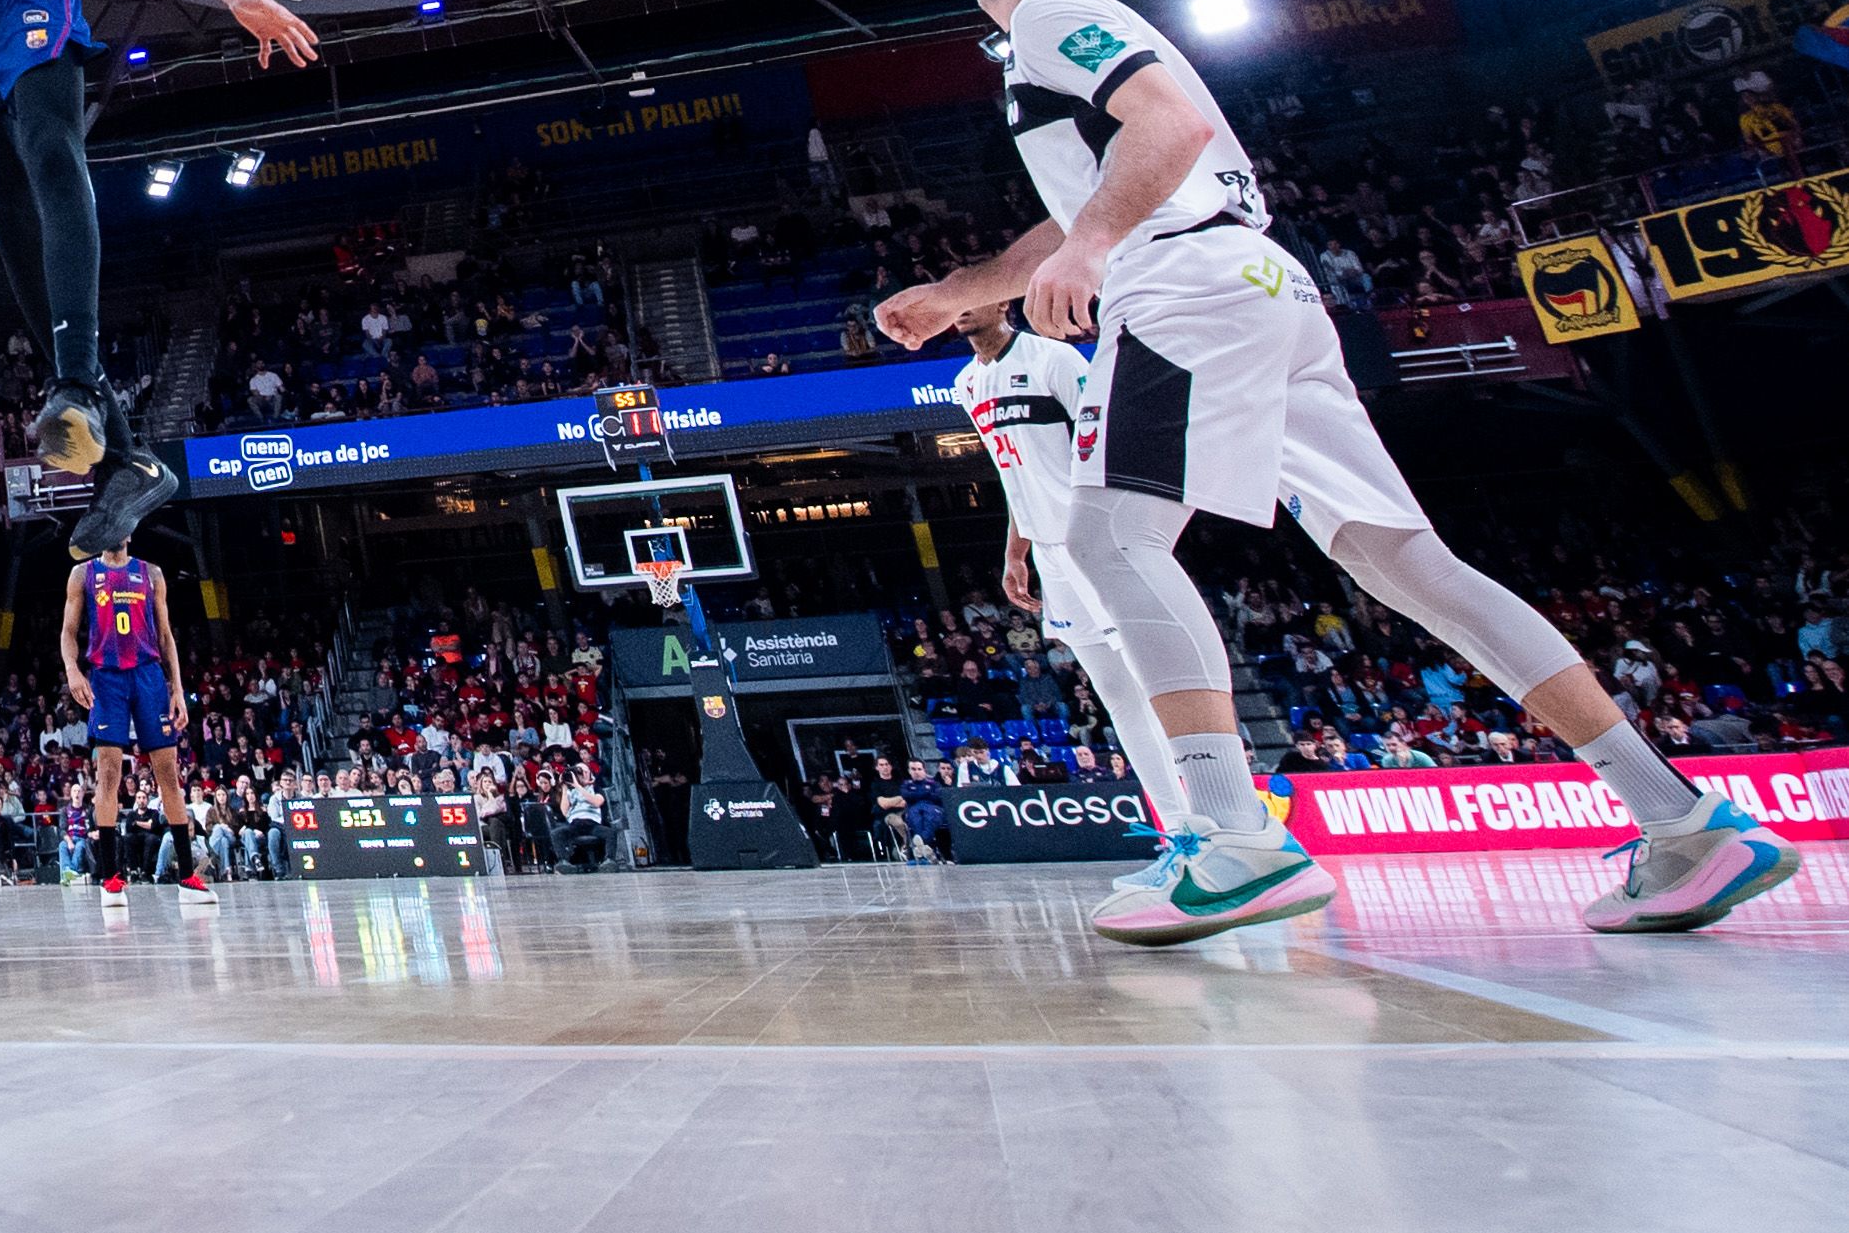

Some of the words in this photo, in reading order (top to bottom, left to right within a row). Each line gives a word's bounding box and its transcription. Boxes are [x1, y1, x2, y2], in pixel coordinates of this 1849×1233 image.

[557, 420, 585, 441] No
[631, 410, 660, 436] 11
[245, 438, 289, 457] nena
[993, 433, 1023, 469] 24
[209, 455, 243, 479] Cap
[295, 444, 333, 467] fora
[335, 442, 358, 463] de
[360, 440, 390, 466] joc
[253, 463, 288, 485] nen
[115, 611, 130, 636] 0
[744, 631, 839, 652] Assistència
[747, 650, 815, 668] Sanitària
[292, 812, 319, 830] 91
[339, 809, 386, 828] 5:51
[404, 810, 417, 825] 4
[441, 807, 468, 826] 55
[957, 789, 1146, 830] endesa
[302, 854, 315, 870] 2
[457, 851, 471, 867] 1
